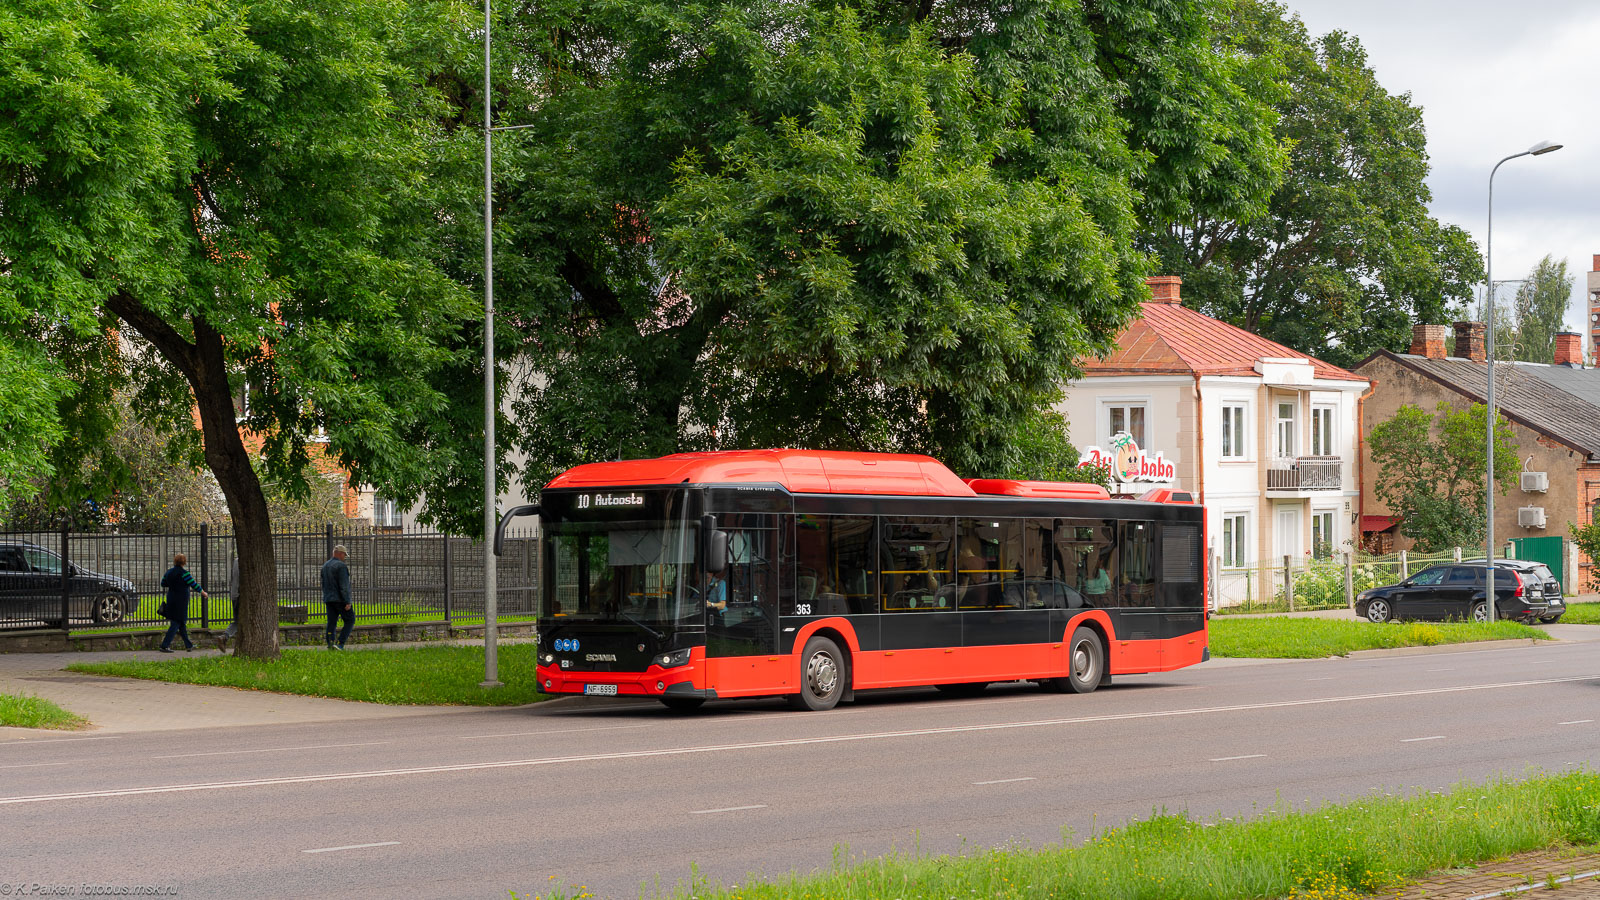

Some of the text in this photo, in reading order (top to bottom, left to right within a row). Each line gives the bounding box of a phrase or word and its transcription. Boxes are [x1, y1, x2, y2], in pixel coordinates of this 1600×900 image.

[1141, 455, 1173, 478] baba
[578, 492, 643, 509] 10 Autoosta
[796, 603, 811, 615] 363
[585, 653, 617, 662] SCANIA
